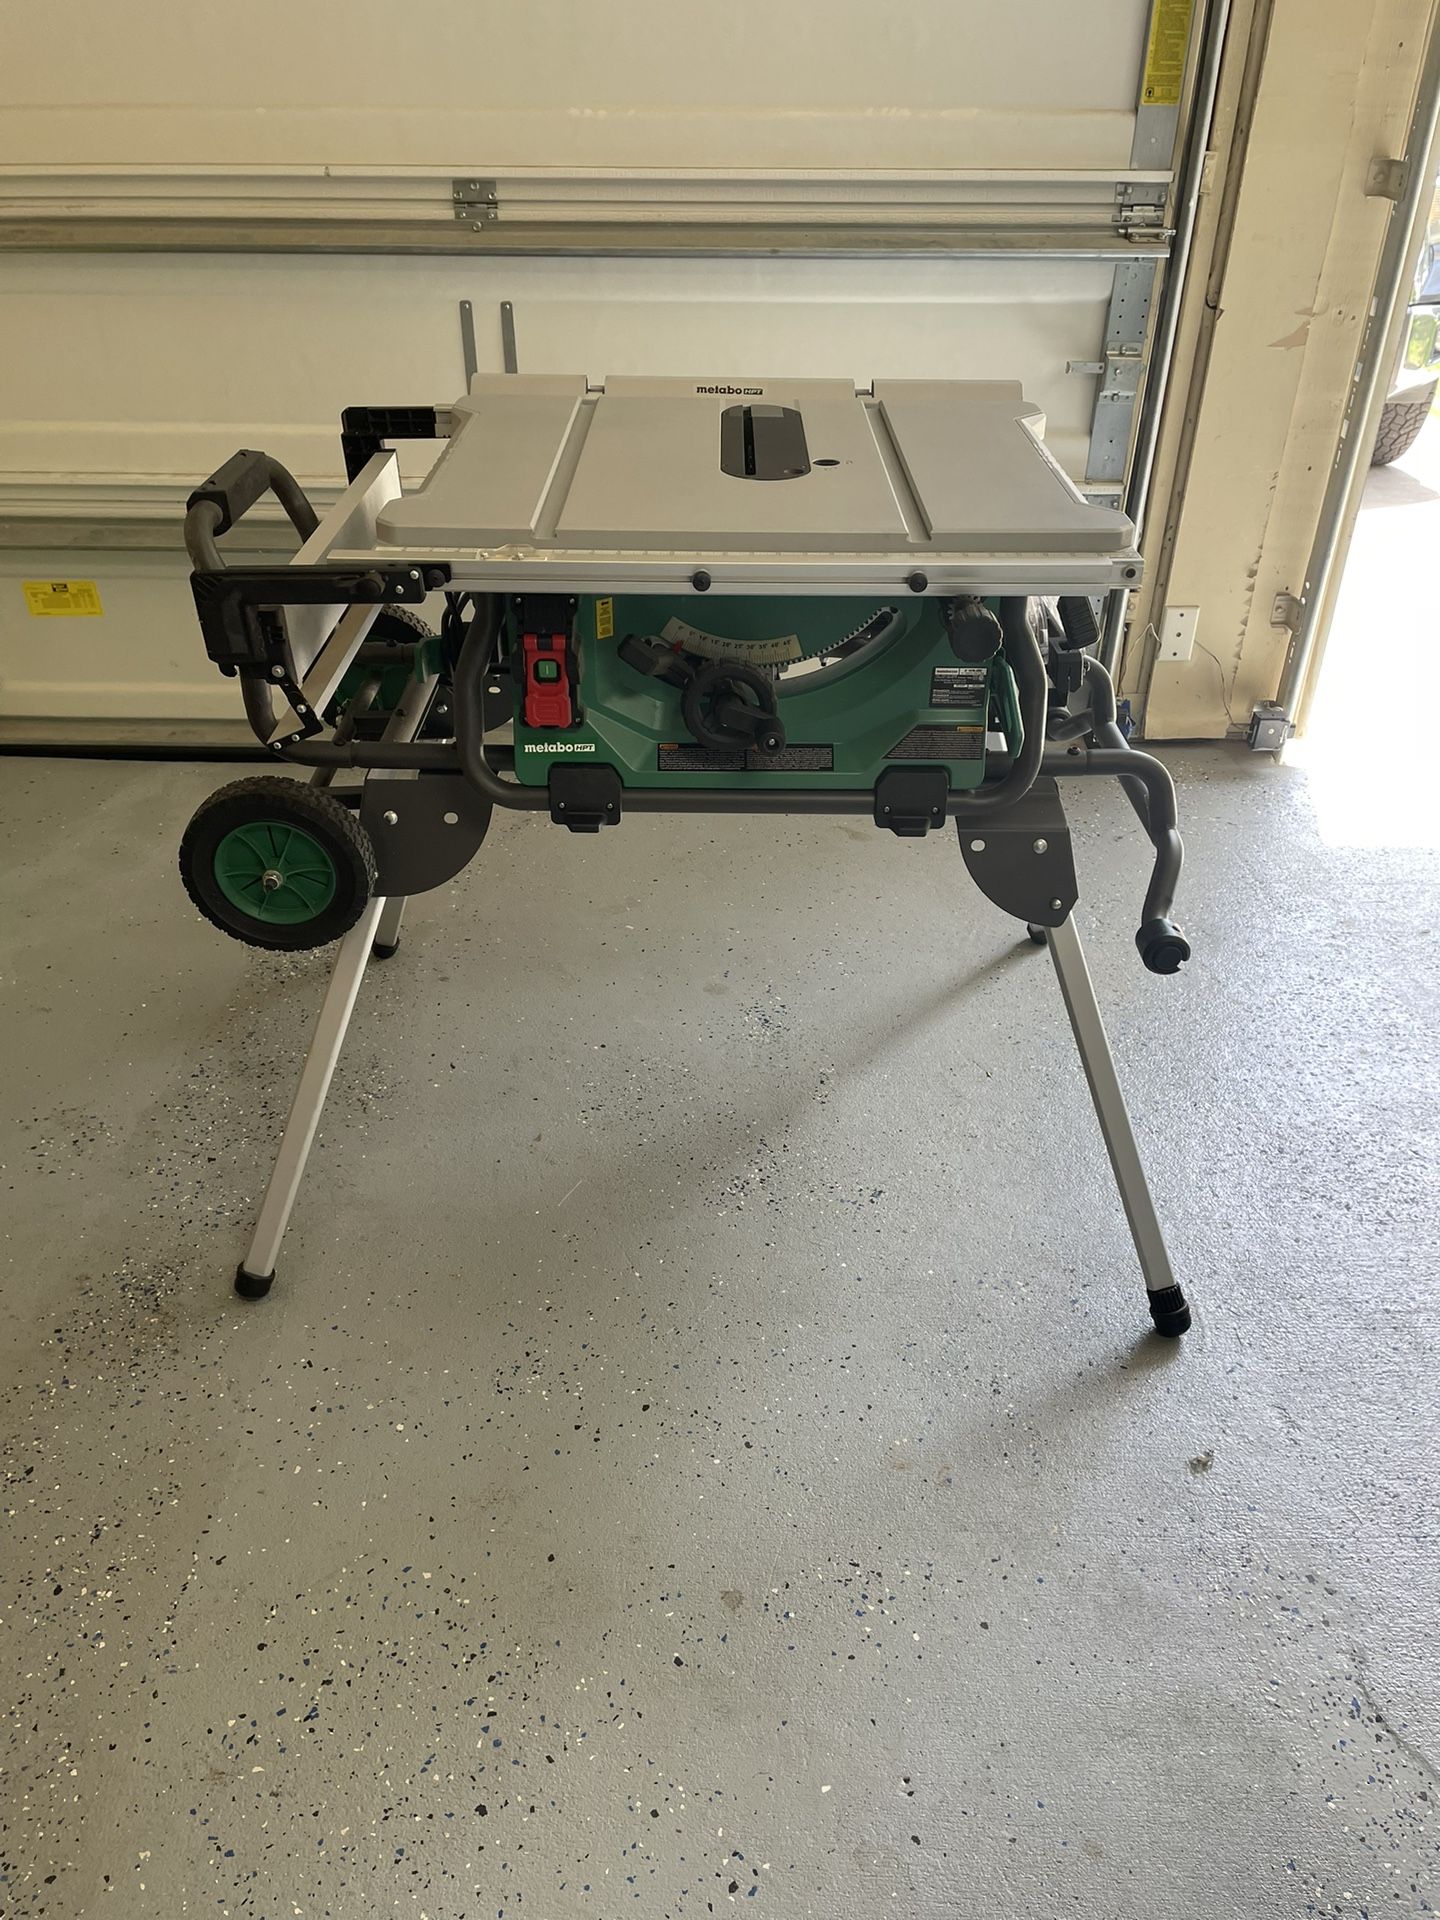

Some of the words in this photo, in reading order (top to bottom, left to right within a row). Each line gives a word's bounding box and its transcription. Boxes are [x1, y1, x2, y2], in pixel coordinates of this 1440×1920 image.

[696, 385, 742, 395] metabo
[524, 741, 573, 752] metabo
[574, 744, 595, 752] HPT
